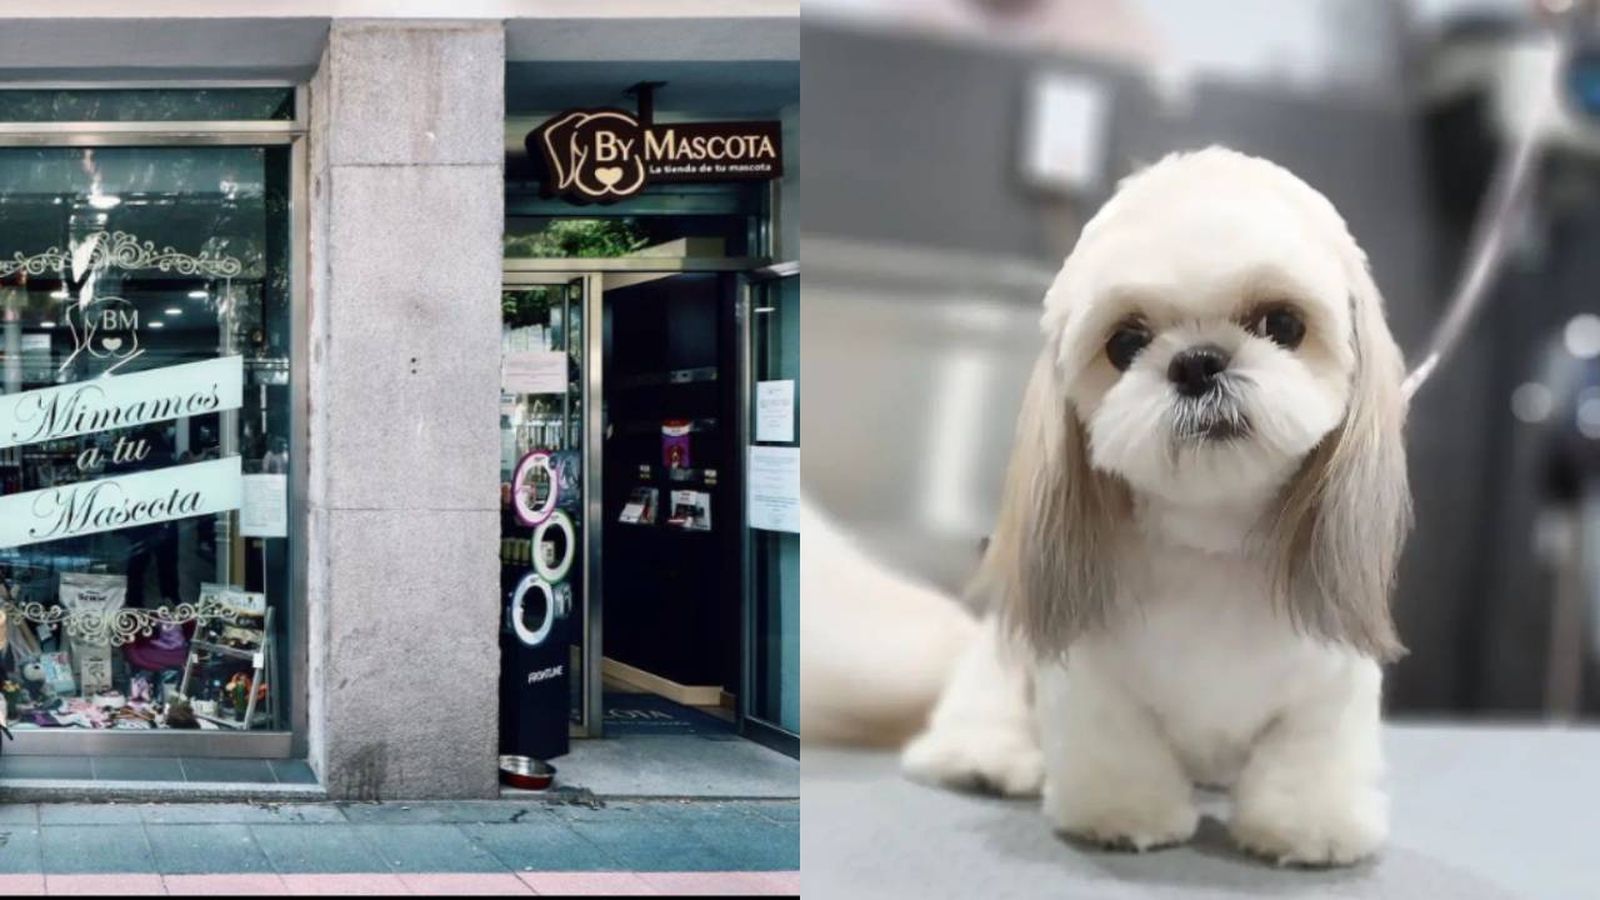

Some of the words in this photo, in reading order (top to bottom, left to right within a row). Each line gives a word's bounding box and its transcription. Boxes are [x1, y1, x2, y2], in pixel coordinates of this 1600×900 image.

[649, 165, 662, 174] La
[664, 163, 697, 173] tienda
[699, 162, 713, 173] de
[715, 163, 727, 172] tu
[729, 162, 771, 172] mascota
[102, 309, 139, 330] BM
[11, 383, 219, 443] Mimamos
[77, 448, 105, 470] a
[112, 435, 151, 464] tu
[29, 480, 204, 538] Mascota
